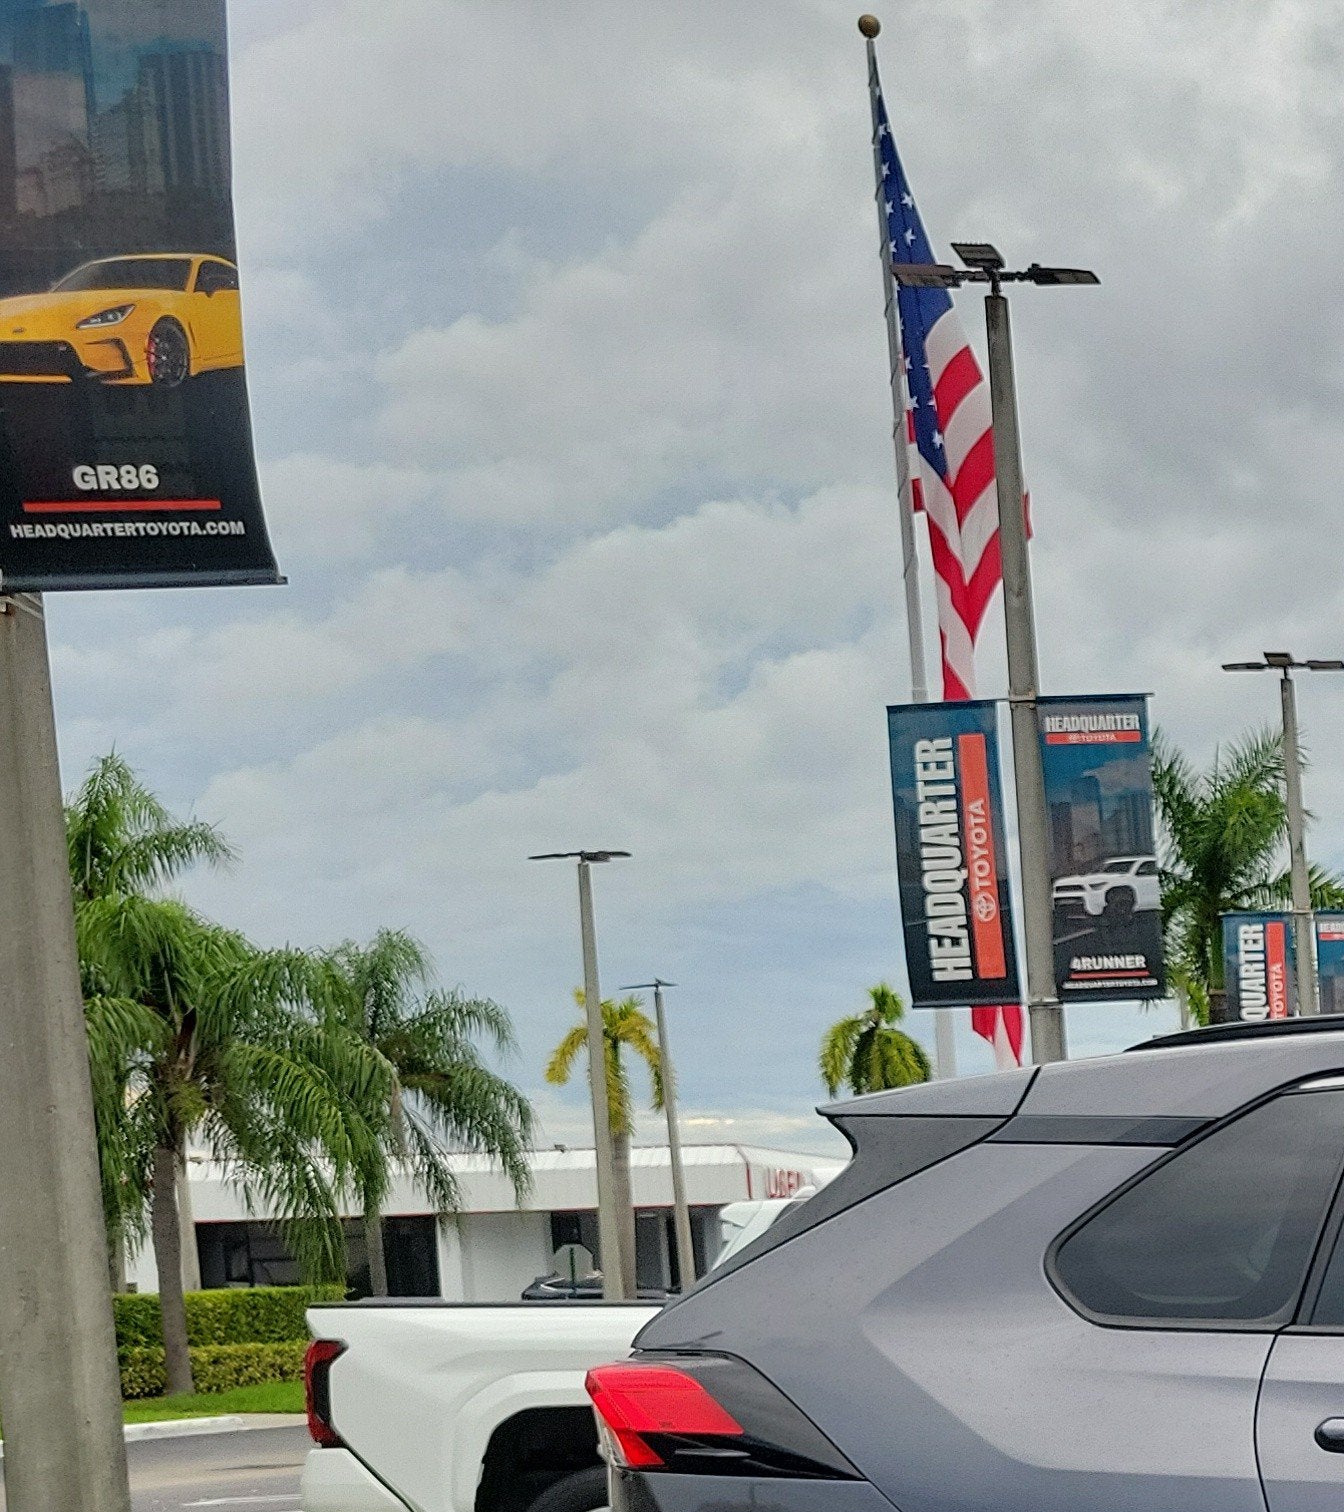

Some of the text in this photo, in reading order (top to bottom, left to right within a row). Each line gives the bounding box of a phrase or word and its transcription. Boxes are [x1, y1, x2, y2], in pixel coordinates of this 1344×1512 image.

[72, 465, 160, 491] GR86
[10, 521, 246, 540] HEADQUARTERTOYOTA.COM
[1045, 714, 1140, 732] HEADQUARTER
[967, 797, 992, 891] TOYOTA
[915, 735, 974, 982] HEADQUARTER
[1069, 954, 1147, 971] 4RUNNER
